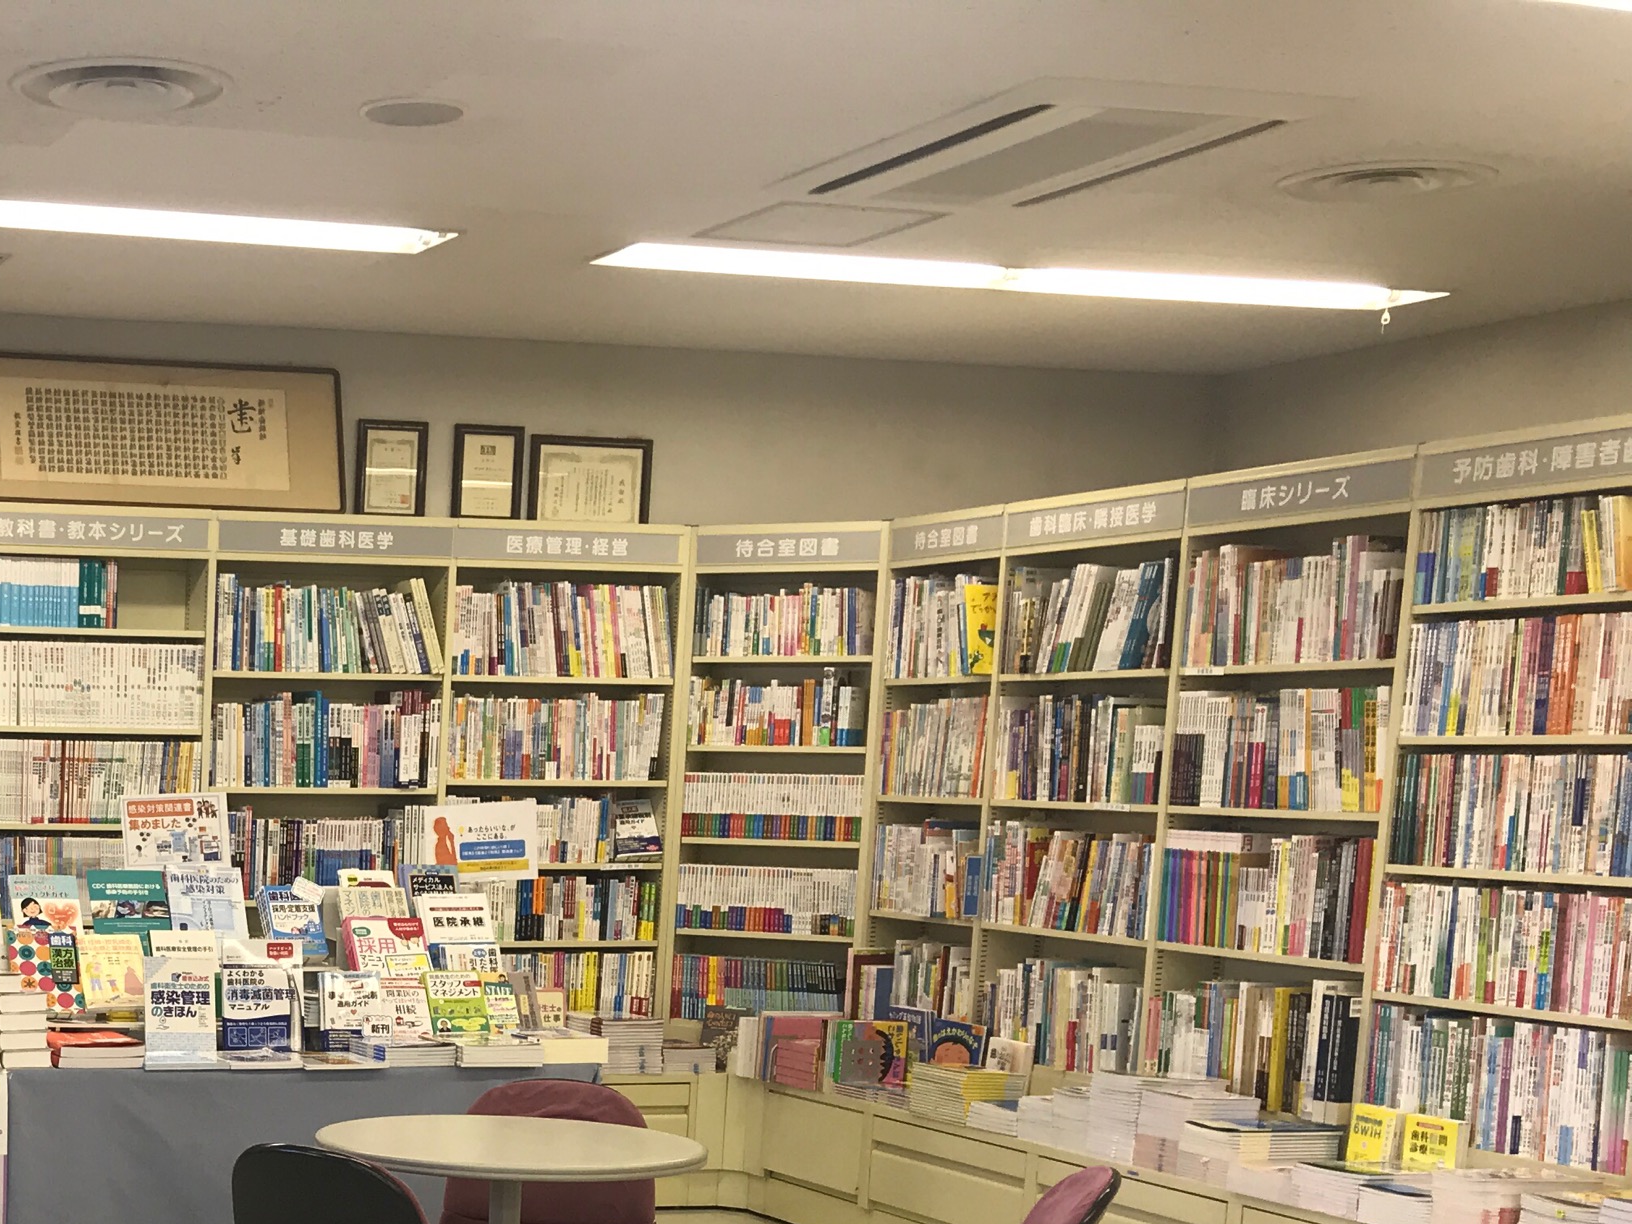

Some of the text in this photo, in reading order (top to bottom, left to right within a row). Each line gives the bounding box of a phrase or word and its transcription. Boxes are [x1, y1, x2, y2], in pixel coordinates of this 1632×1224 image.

[1241, 476, 1349, 511] 臨床シリーズ
[280, 528, 395, 550] 基礎歯科医学
[506, 535, 629, 557] 医療管理・経営
[735, 537, 840, 557] 待合室図書
[129, 818, 181, 831] 集めました
[170, 874, 239, 884] 歯科医院のための
[185, 885, 226, 895] 感染対策
[432, 916, 485, 927] 医院承継
[50, 935, 73, 946] 歯科
[357, 937, 397, 954] 採用
[53, 958, 75, 968] 治療
[227, 978, 265, 986] 歯科医院の
[226, 988, 296, 1001] 消毒滅菌管理
[432, 988, 480, 996] マネジメント
[151, 991, 210, 1006] 感染管理
[151, 1006, 197, 1018] のきほん
[229, 1003, 270, 1011] マニュアル
[395, 1004, 417, 1014] 相続
[543, 1015, 561, 1023] 仕事
[371, 1024, 390, 1035] 新刊
